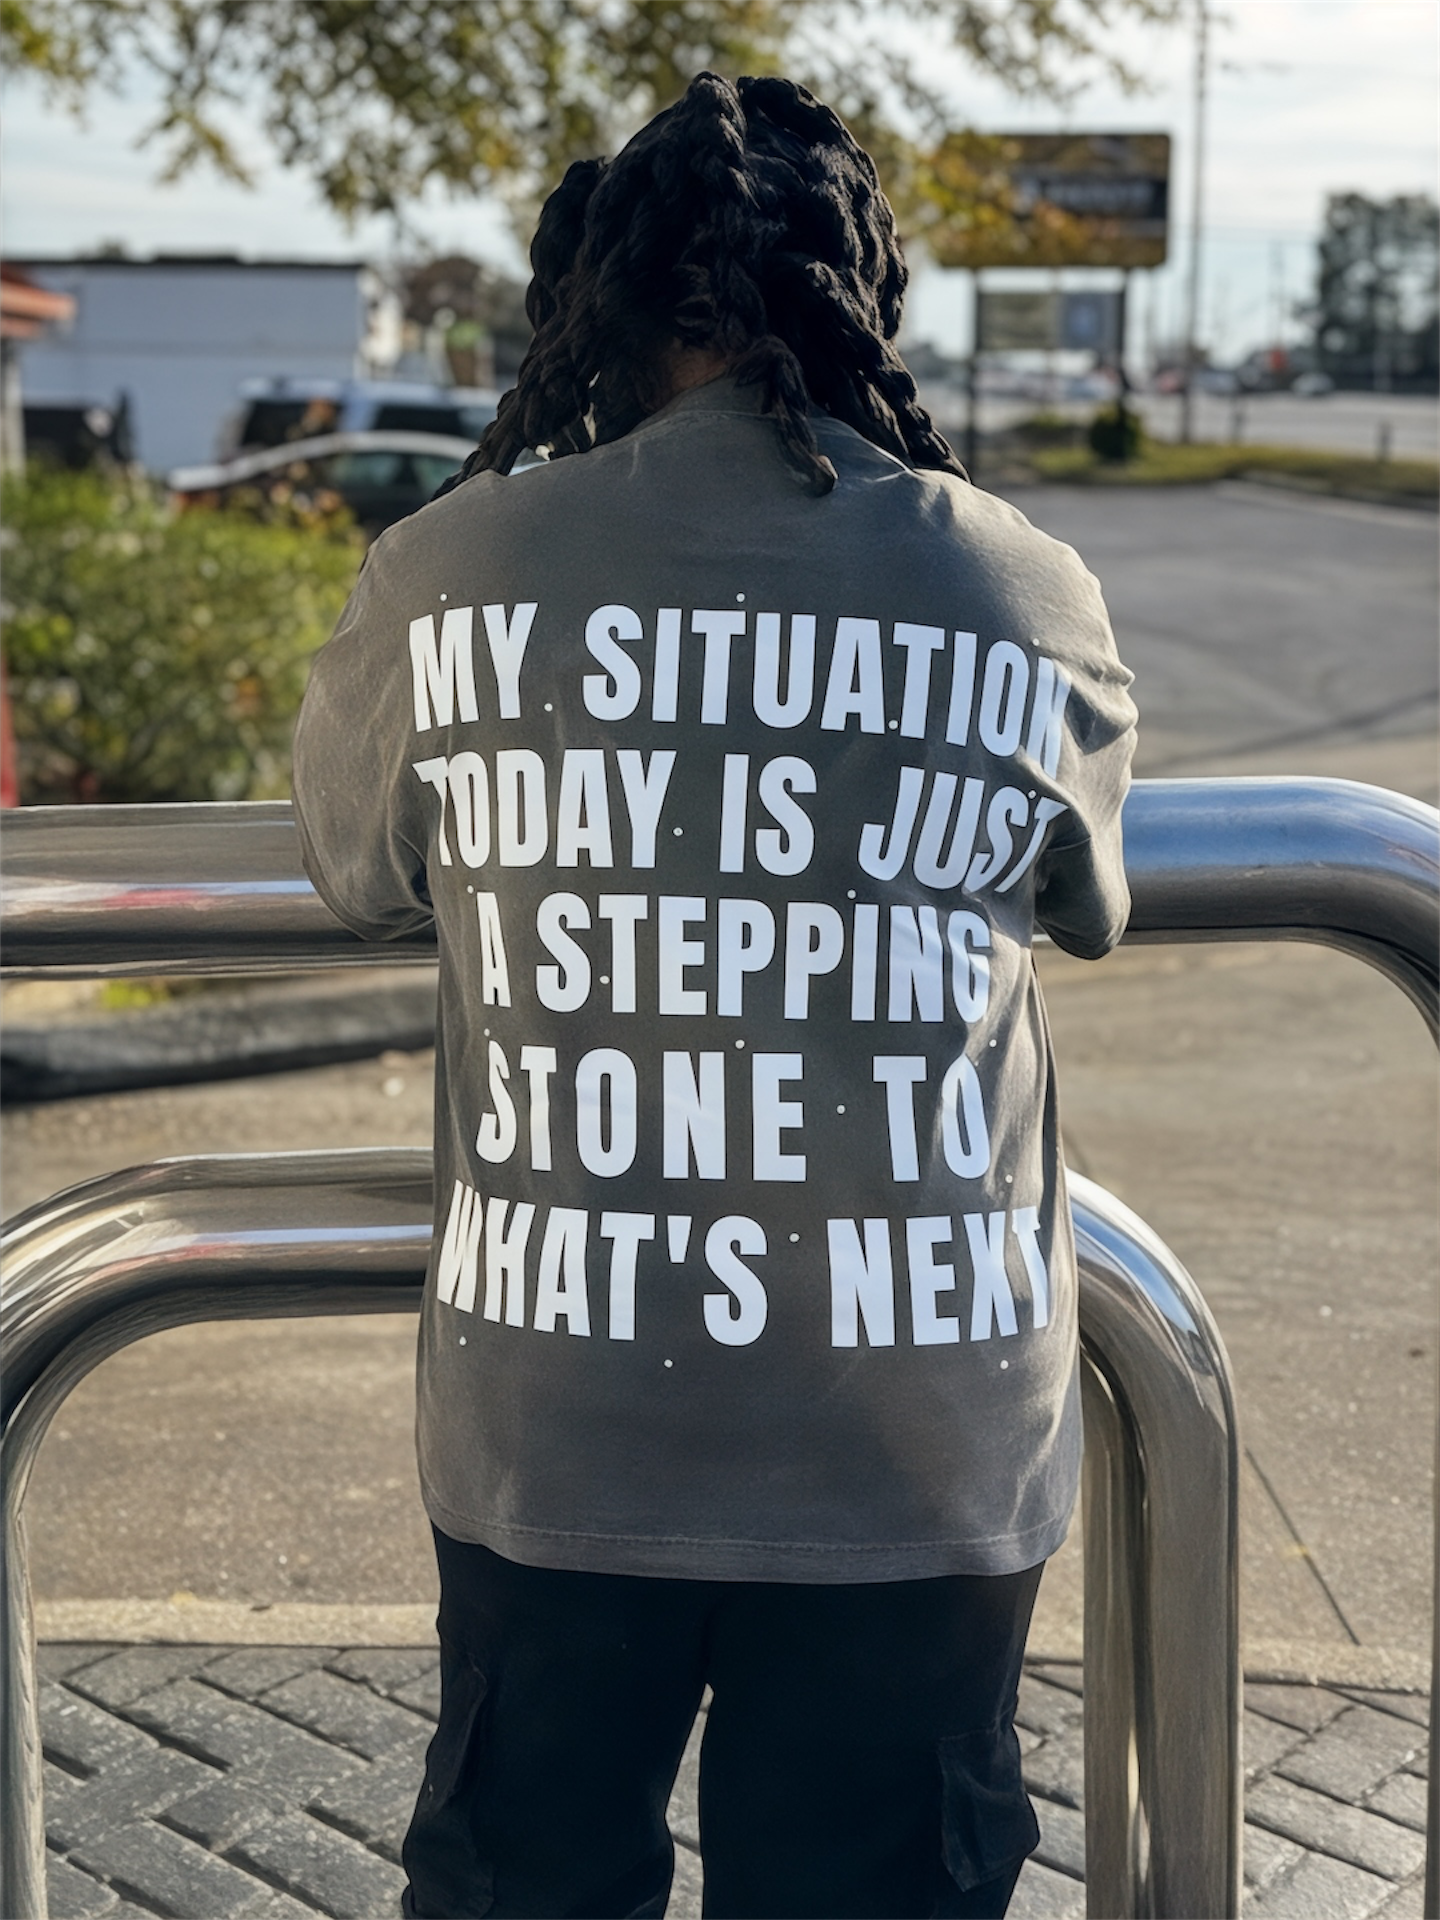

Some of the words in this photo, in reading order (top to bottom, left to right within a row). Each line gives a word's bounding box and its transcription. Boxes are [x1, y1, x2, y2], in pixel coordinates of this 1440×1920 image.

[409, 602, 538, 732] MY
[583, 604, 1072, 780] SITUATION
[412, 749, 677, 868] TODAY
[720, 753, 817, 876] IS
[858, 766, 1069, 894] JUST
[477, 891, 511, 1007] A
[536, 892, 990, 1023] STEPPING
[476, 1040, 806, 1182] STONE
[873, 1053, 990, 1181] TO
[437, 1180, 768, 1346] WHAT'S
[827, 1206, 1049, 1347] NEXT
